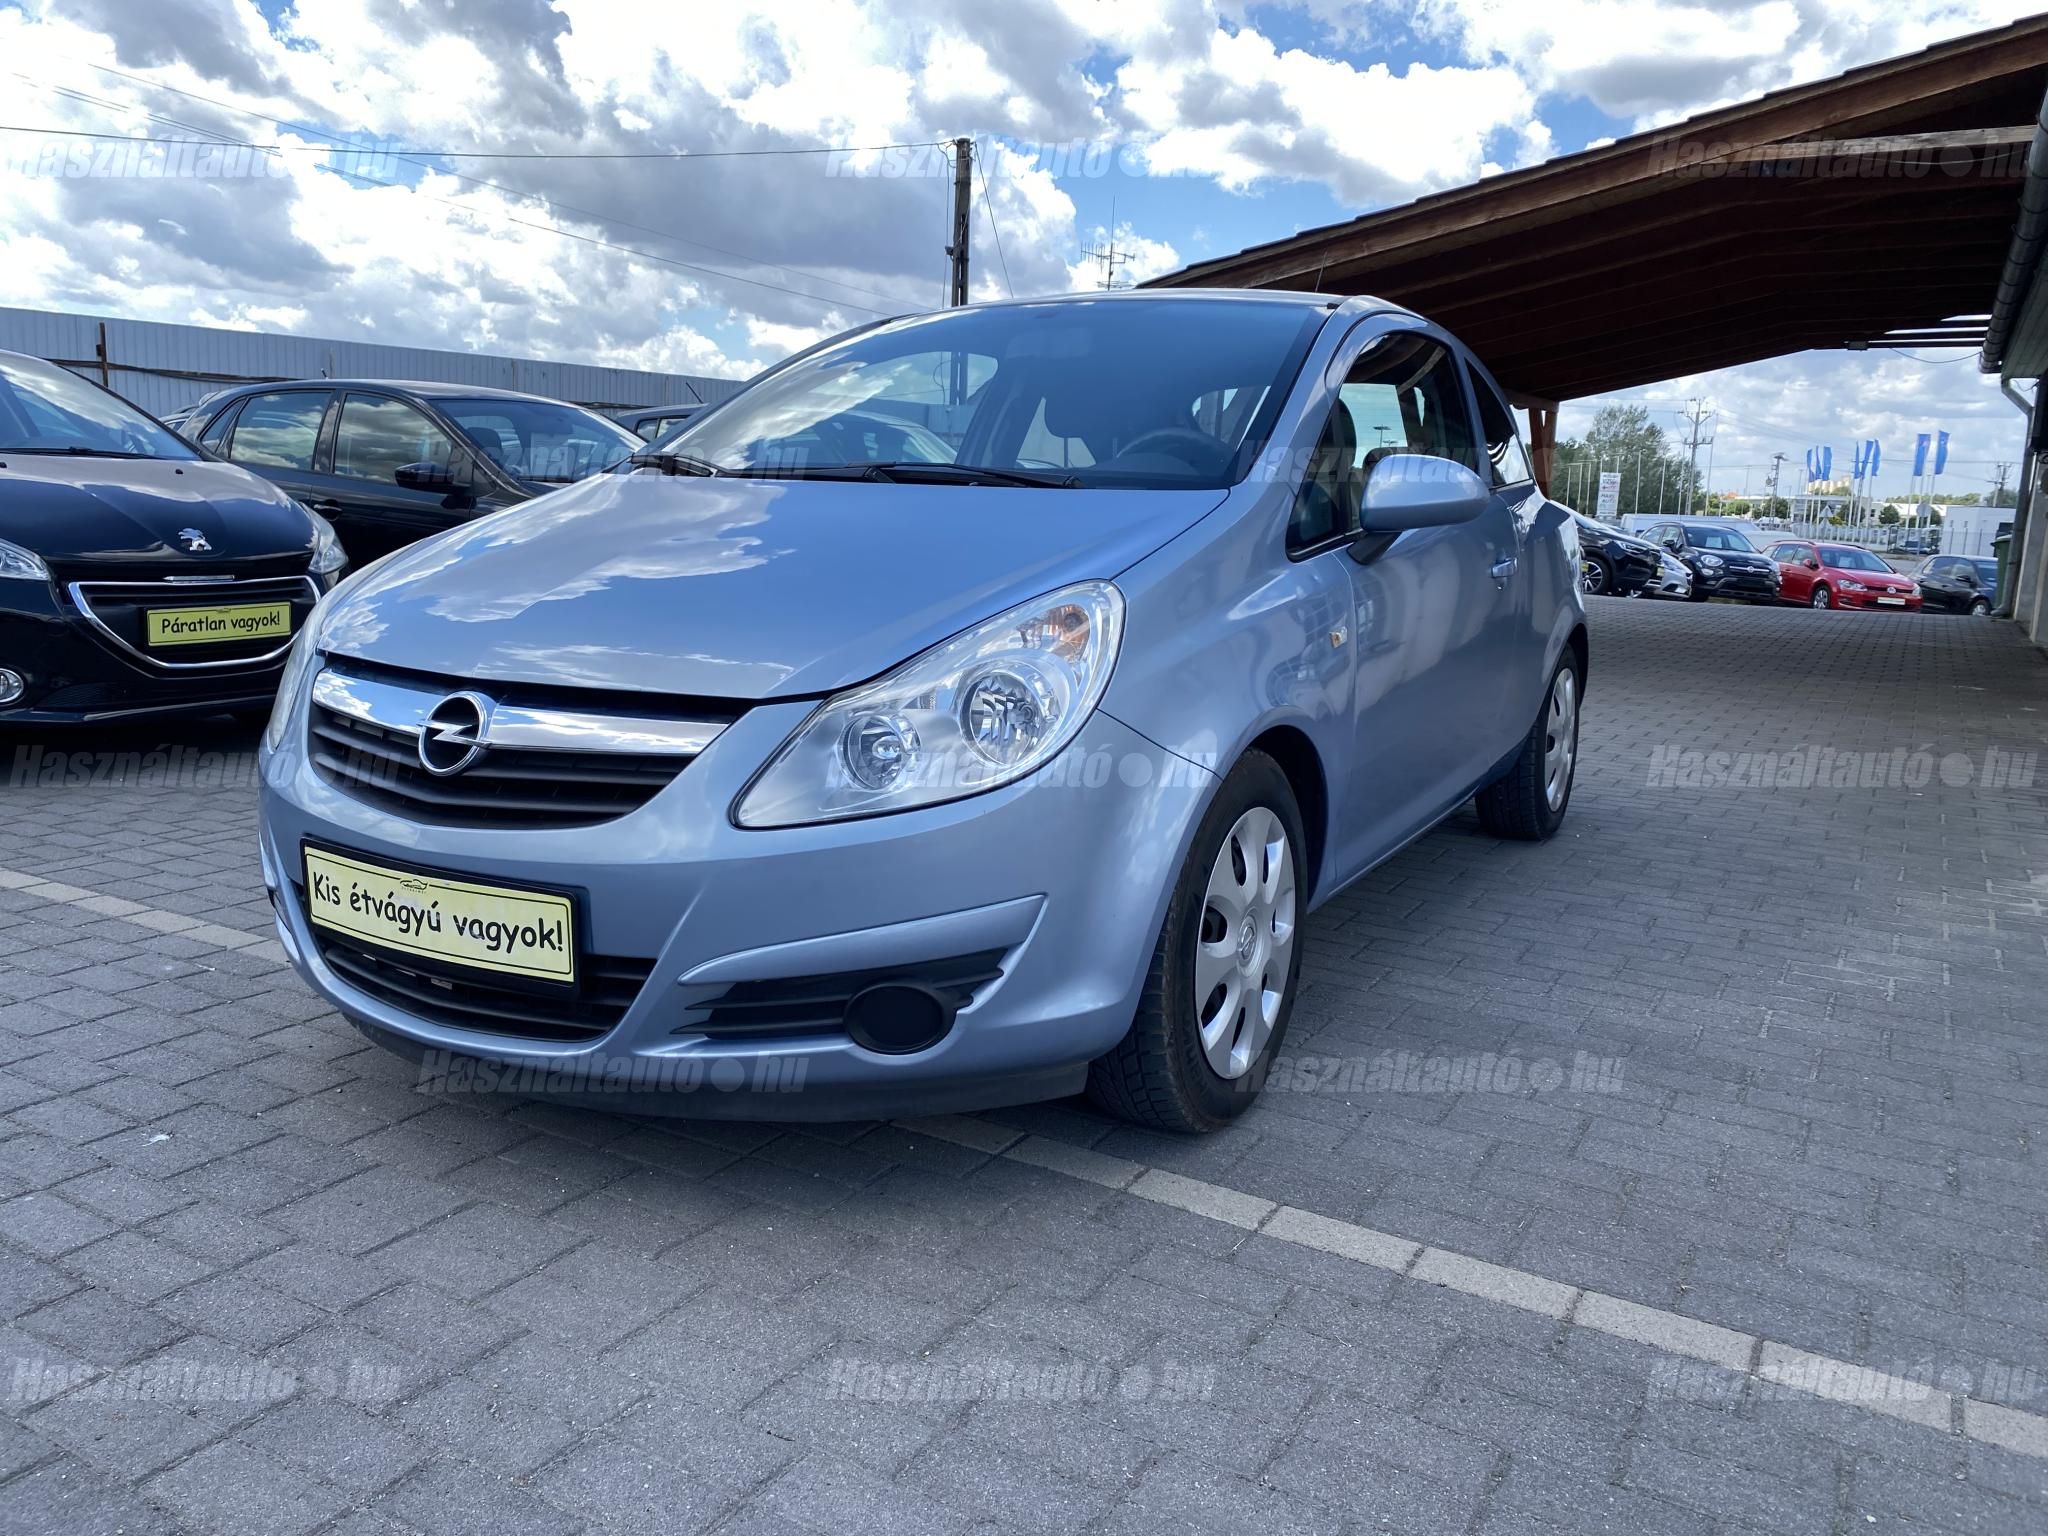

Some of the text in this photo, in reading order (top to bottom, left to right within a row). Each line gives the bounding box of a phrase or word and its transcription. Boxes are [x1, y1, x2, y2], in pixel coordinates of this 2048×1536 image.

[161, 611, 280, 634] Páratlan vagyok!
[313, 872, 564, 954] Kis étvágyú vagyok!
